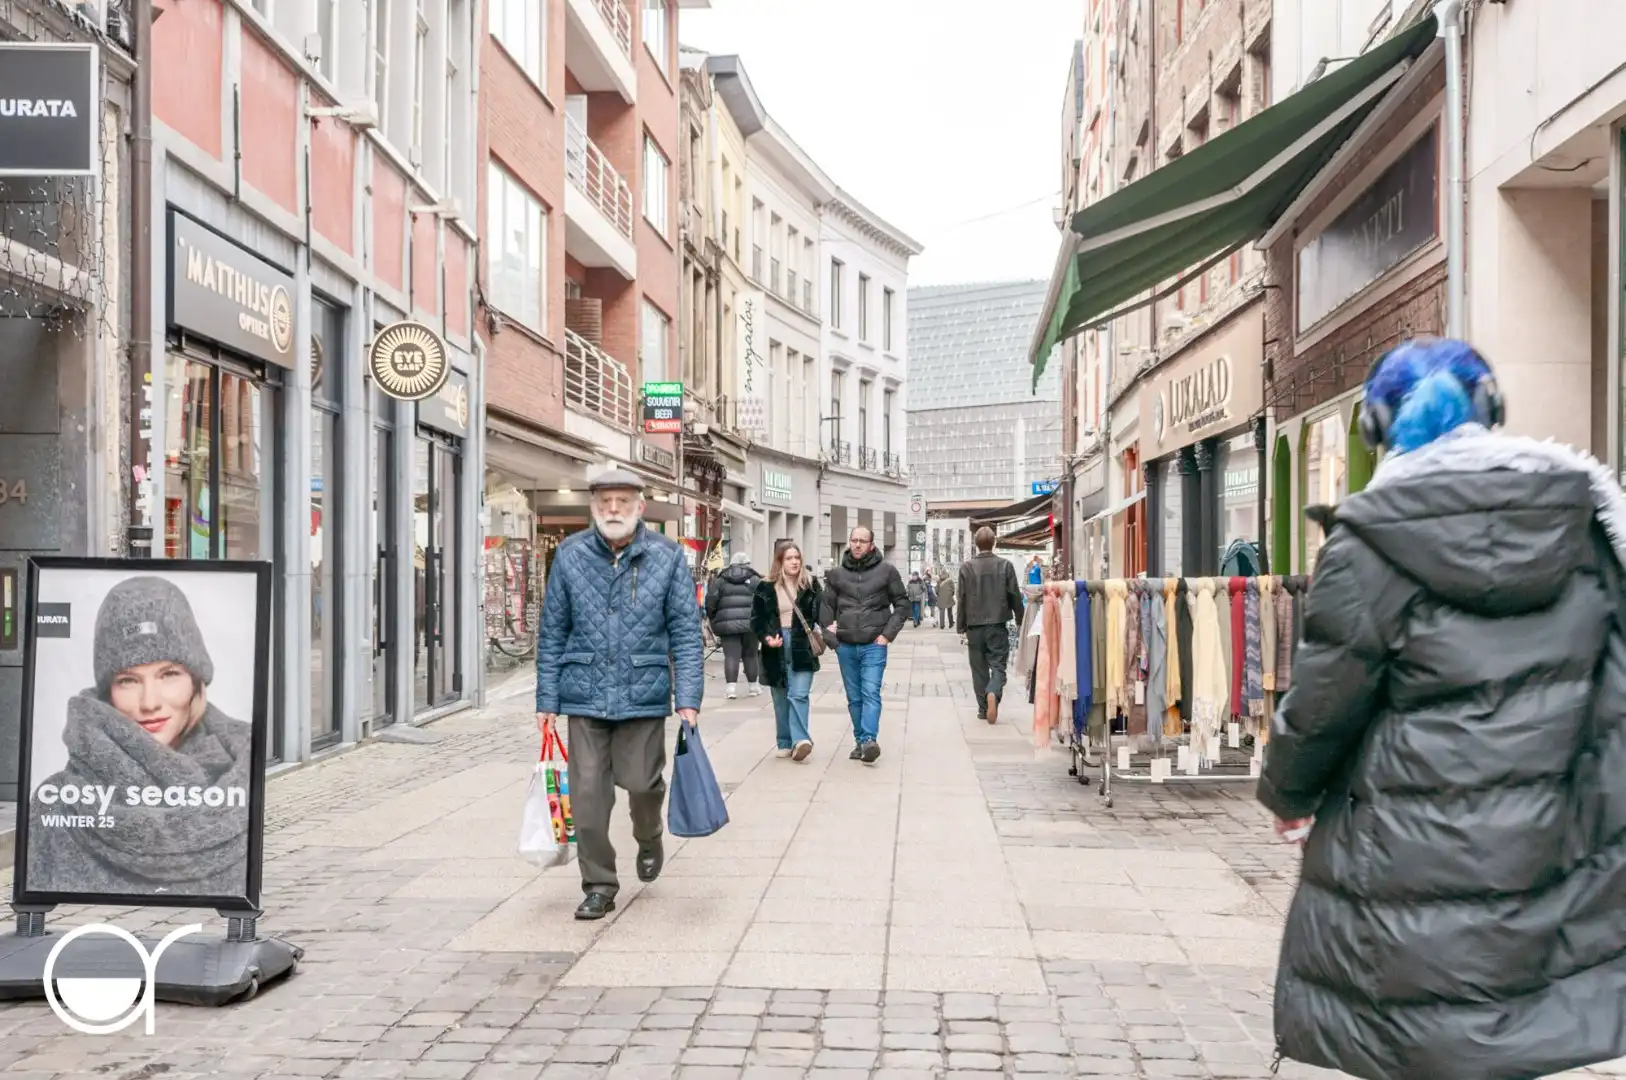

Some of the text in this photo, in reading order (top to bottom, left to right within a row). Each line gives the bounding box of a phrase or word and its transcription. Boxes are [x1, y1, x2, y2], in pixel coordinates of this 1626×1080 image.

[0, 98, 78, 117] URATA
[186, 245, 270, 316] MATTHIJS
[394, 350, 423, 364] EYE
[1169, 357, 1228, 427] LUXALAD
[646, 396, 681, 407] SOUVENIR
[654, 408, 673, 419] BEER
[38, 782, 246, 814] cosy season
[41, 815, 115, 829] WINTER 25
